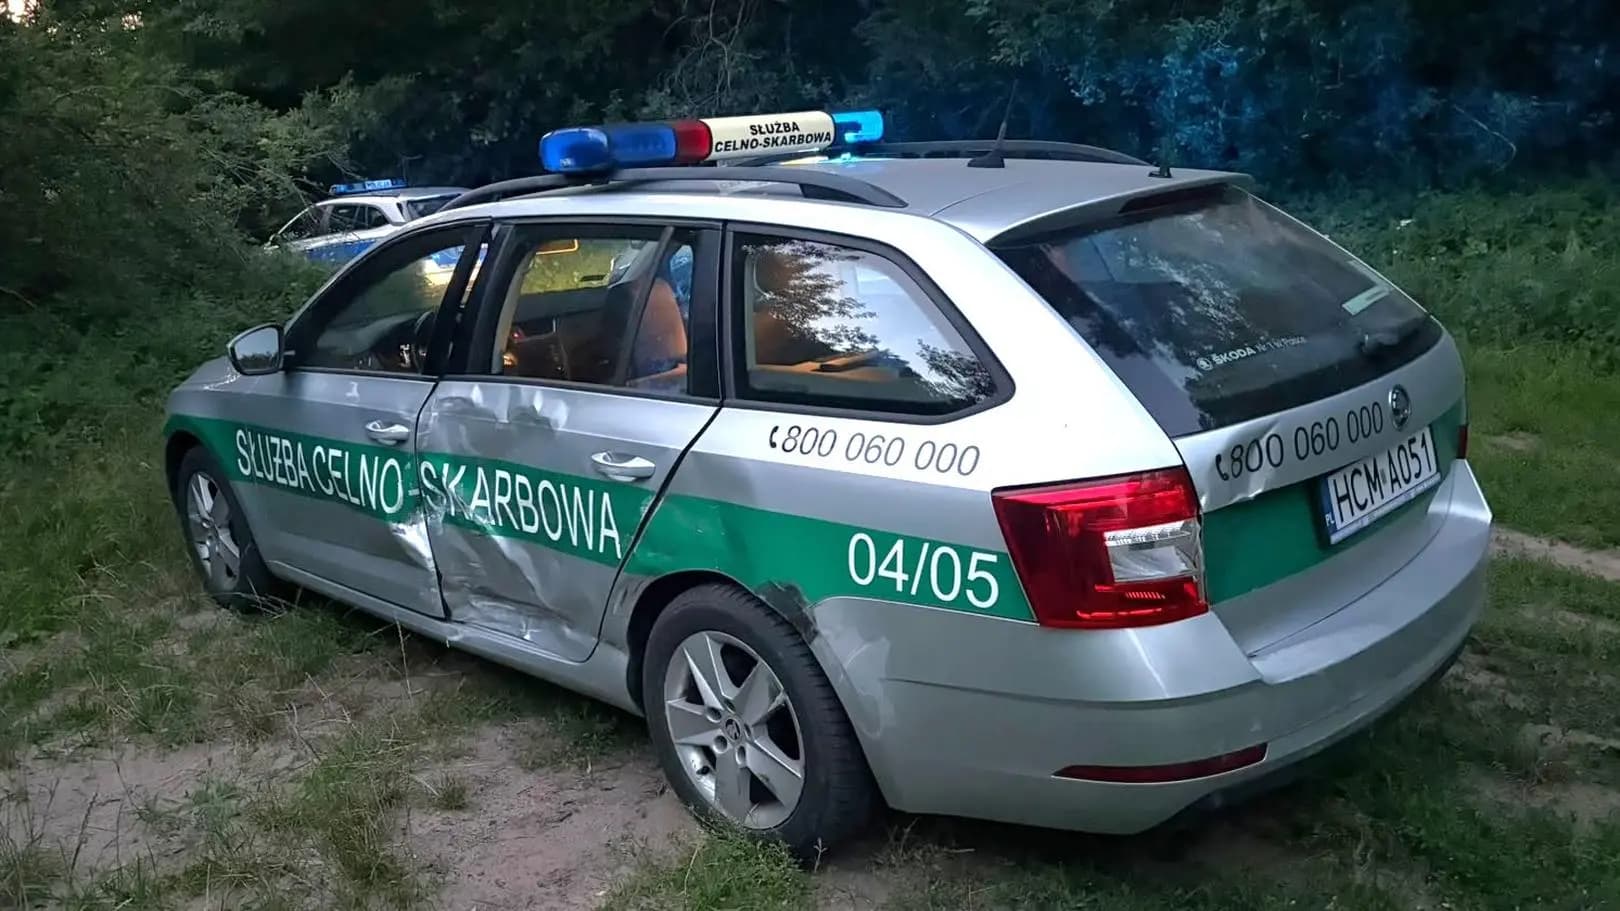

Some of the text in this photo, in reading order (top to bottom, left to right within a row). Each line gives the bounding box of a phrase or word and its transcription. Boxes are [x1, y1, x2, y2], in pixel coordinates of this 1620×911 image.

[714, 131, 832, 153] CELNO-SKARBOWA
[749, 121, 800, 136] SŁUŻBA
[1211, 346, 1257, 365] ŠKODA
[781, 425, 980, 476] 800 060 000
[1230, 401, 1384, 479] 800 060 000
[1333, 432, 1432, 523] HCM A051
[848, 532, 999, 609] 04/05
